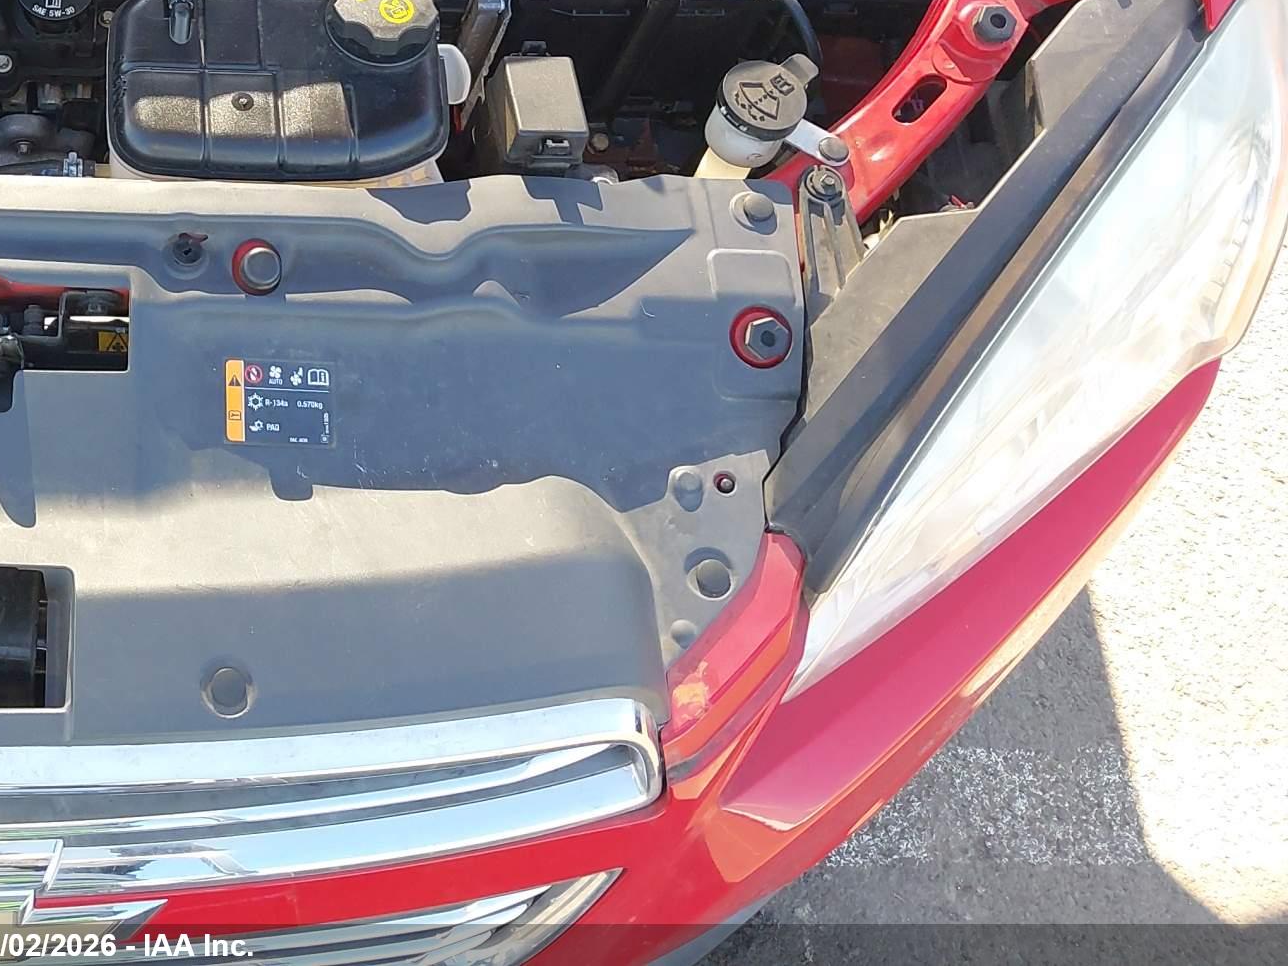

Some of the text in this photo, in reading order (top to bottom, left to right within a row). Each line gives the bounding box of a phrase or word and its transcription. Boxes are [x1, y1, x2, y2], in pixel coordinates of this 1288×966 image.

[32, 4, 75, 17] SAE 5W-30
[265, 398, 289, 407] R-134a
